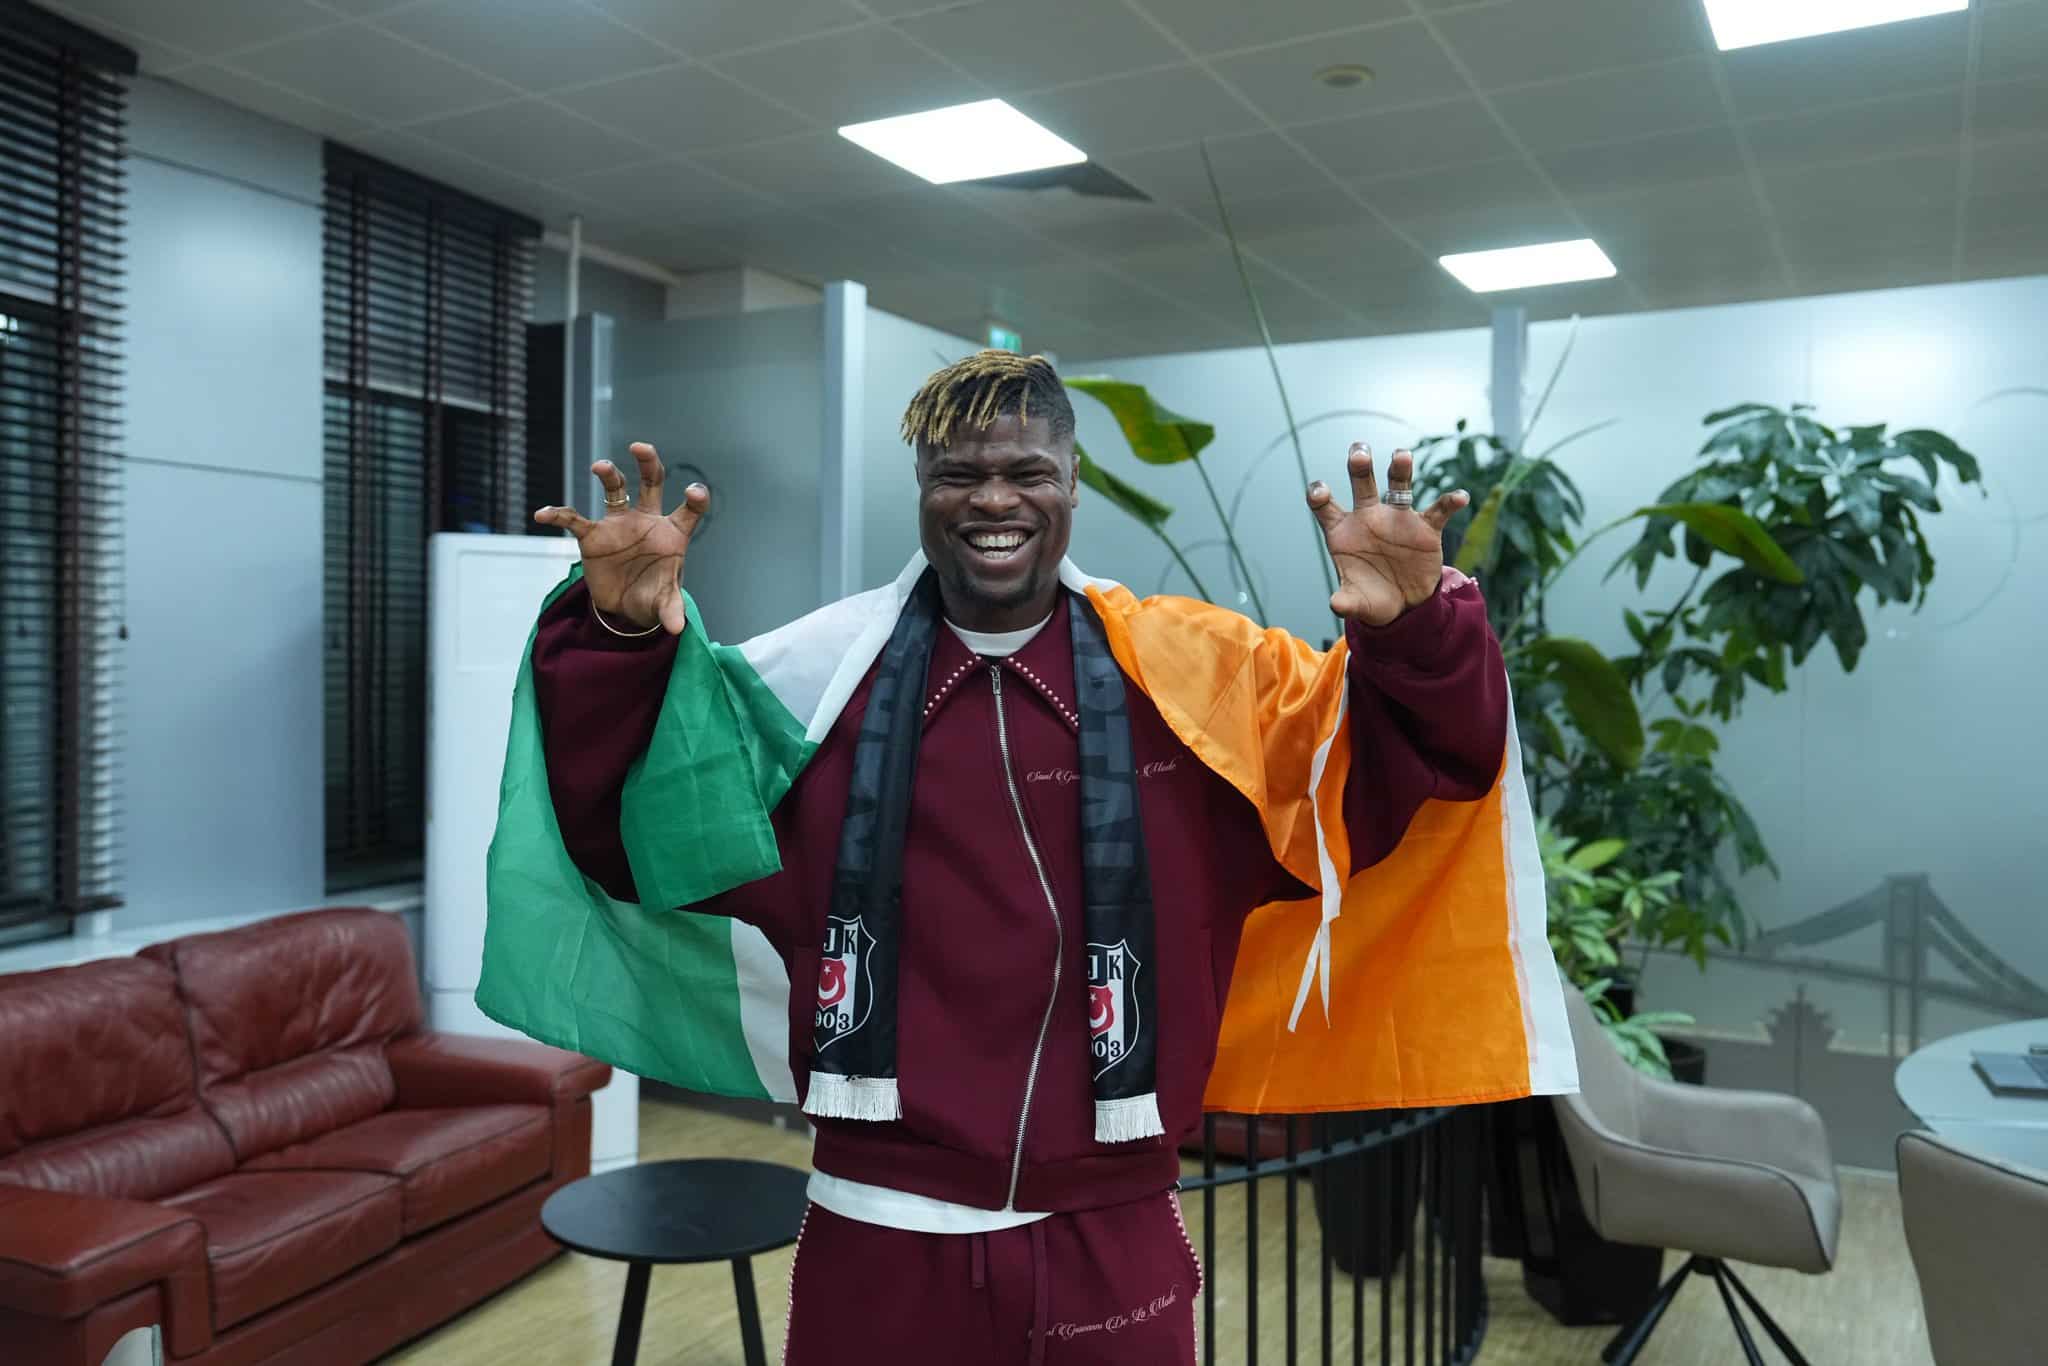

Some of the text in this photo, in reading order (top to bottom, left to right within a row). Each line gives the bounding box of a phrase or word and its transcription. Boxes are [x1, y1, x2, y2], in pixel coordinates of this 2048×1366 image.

[824, 927, 857, 955] JK
[1088, 954, 1122, 980] JK
[815, 1010, 850, 1031] 903
[1091, 1040, 1121, 1058] 03
